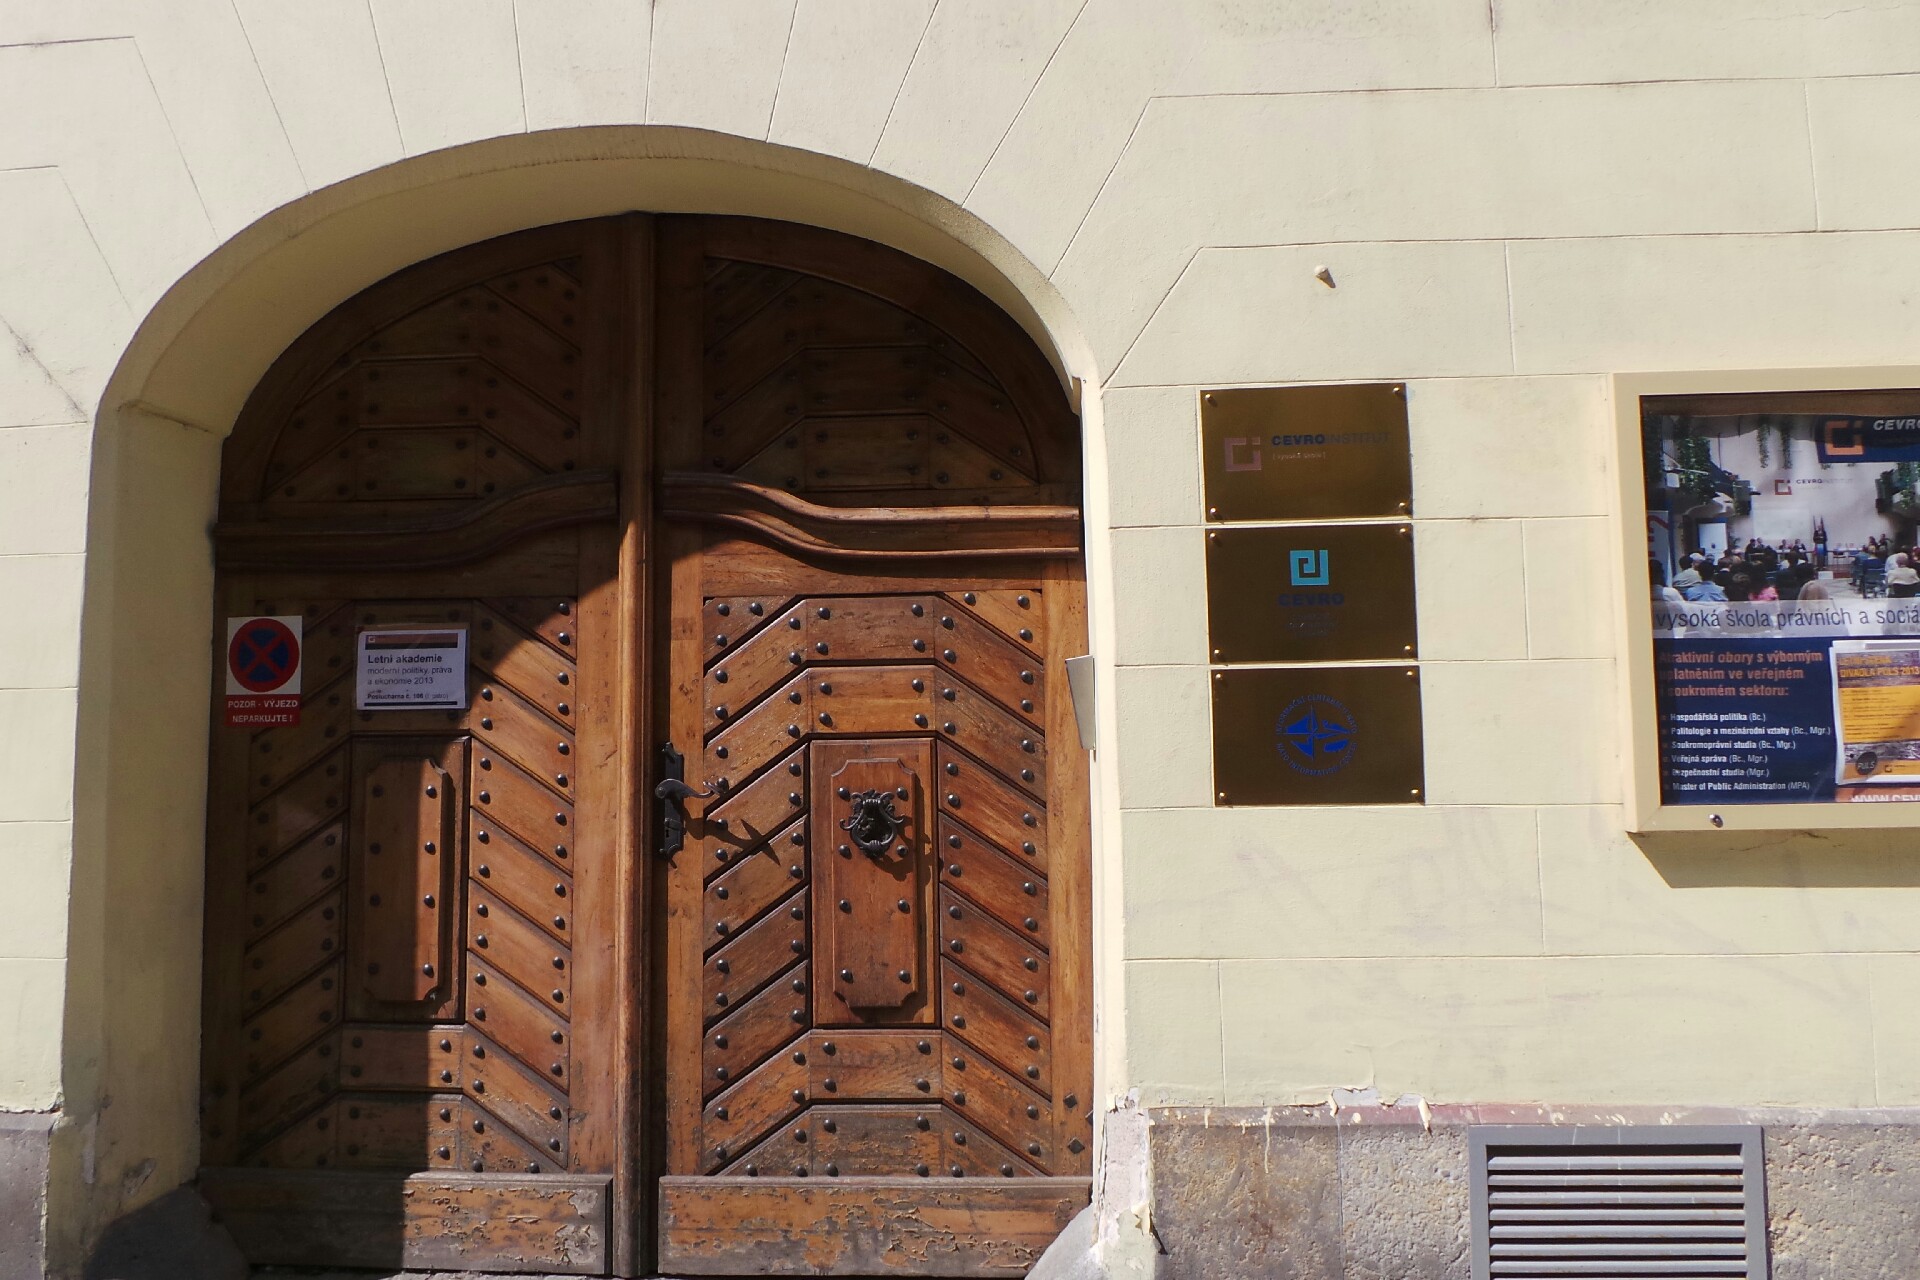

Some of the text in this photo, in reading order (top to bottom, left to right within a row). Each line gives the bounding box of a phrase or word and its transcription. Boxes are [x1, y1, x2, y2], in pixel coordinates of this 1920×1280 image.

[1277, 592, 1344, 607] CEVRO
[1656, 609, 1720, 630] vysoká
[1726, 609, 1771, 627] škola
[1777, 608, 1852, 630] právních
[1859, 611, 1870, 624] a
[367, 653, 443, 664] Letní akademie
[1718, 651, 1754, 665] obory
[1756, 653, 1764, 663] s
[1767, 650, 1823, 665] výborným
[367, 667, 400, 675] moderní
[431, 666, 453, 675] práva
[1728, 670, 1744, 680] ve
[1747, 667, 1805, 682] veřejném
[414, 677, 434, 685] 2013
[1739, 684, 1789, 697] sektoru:
[228, 700, 256, 709] POZOR
[263, 698, 299, 708] VÝJEZD
[232, 714, 288, 723] NEPARKUJTE
[1670, 712, 1766, 722] Hospodářská politika (Bc.)
[1671, 727, 1711, 736] Politologie
[1720, 726, 1765, 735] mezinárodní
[1767, 726, 1790, 736] vztahy
[1791, 726, 1808, 735] (Bc.,
[1809, 726, 1831, 736] Mgr.)
[1672, 740, 1796, 750] Soukromoprávní studia (Bc., Mgr.)
[1671, 754, 1768, 764] Veřejná správa (Bc., Mgr.)
[1672, 768, 1770, 778] Bezpečnostní studia (Mgr.)
[1673, 781, 1810, 791] Master of Public Administration (MPA)
